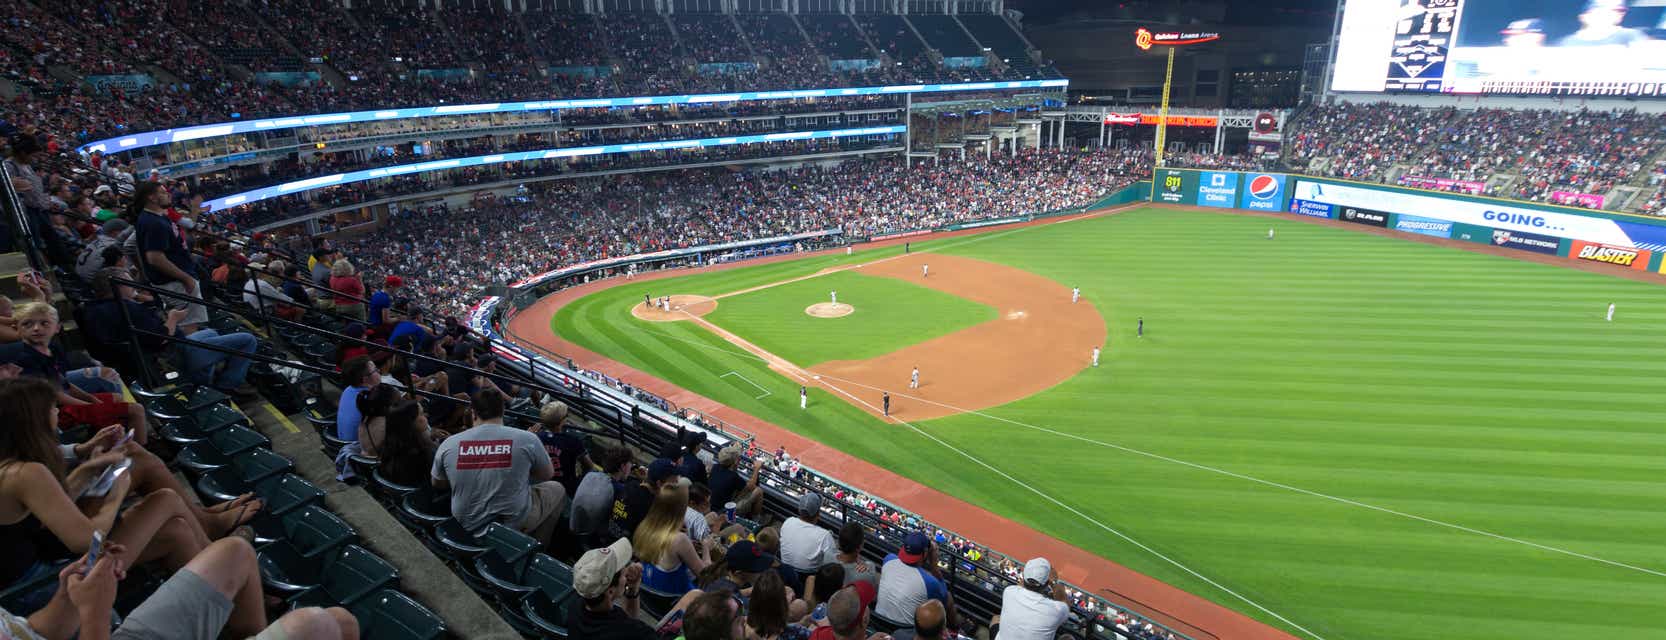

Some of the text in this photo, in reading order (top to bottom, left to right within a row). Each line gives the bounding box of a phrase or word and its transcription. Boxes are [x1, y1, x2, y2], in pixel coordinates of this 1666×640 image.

[1166, 176, 1181, 187] 811
[1200, 186, 1235, 194] Cleveland
[1356, 212, 1384, 222] RAM
[1483, 210, 1565, 230] GOING...
[460, 444, 511, 456] LAWLER
